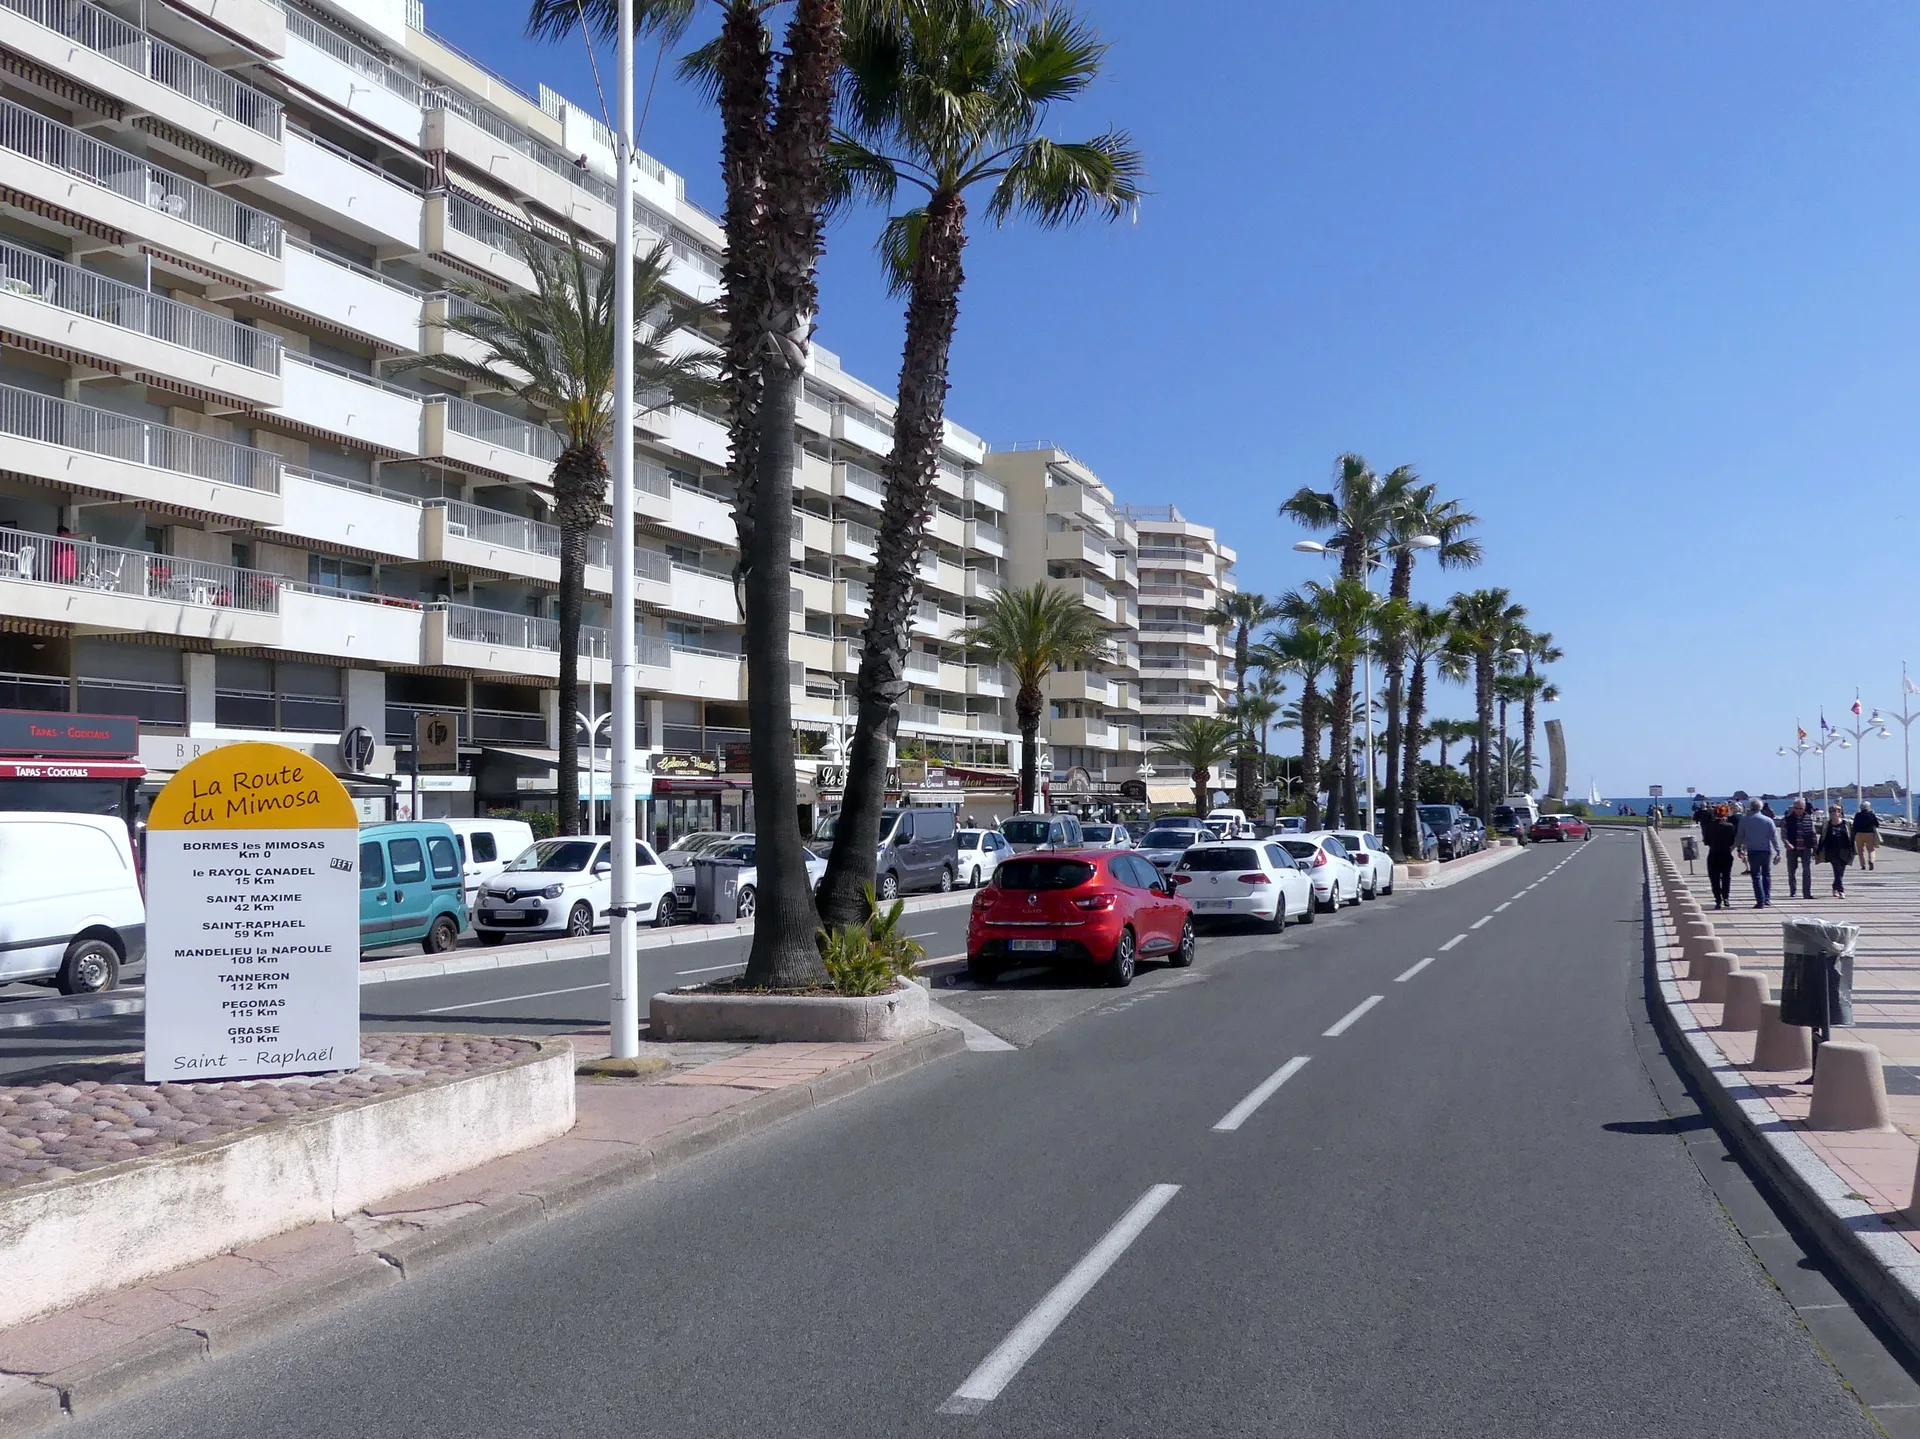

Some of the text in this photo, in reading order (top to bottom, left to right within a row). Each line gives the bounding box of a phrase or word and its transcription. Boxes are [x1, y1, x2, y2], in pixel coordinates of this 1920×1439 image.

[30, 724, 58, 737] TAPAS
[67, 727, 111, 739] COCKTAILS
[15, 766, 41, 777] TAPAS
[47, 767, 89, 777] COCKTAILS
[193, 765, 304, 799] La Route
[183, 789, 320, 825] du Mimosa
[183, 841, 325, 851] BORMES les MIMOSAS
[239, 850, 271, 859] Km 0
[331, 858, 352, 871] DEFT
[193, 867, 316, 877] le RAYOL CANADEL
[235, 877, 275, 885] 15 Km
[206, 893, 302, 904] SAINT MAXIME
[234, 903, 275, 912] 42 Km
[202, 920, 306, 930] SAINT-RAPHAEL
[234, 930, 275, 938] 59 Km
[174, 945, 333, 957] MANDELIEU la NAPOULE
[230, 955, 278, 965] 108 Km
[217, 972, 290, 982] TANNERON
[230, 982, 278, 991] 112 Km
[222, 999, 286, 1009] PEGOMAS
[230, 1008, 278, 1018] 115 Km
[227, 1025, 280, 1035] GRASSE
[230, 1035, 278, 1044] 130 Km
[173, 1053, 228, 1070] Saint
[256, 1046, 334, 1068] Raphaël
